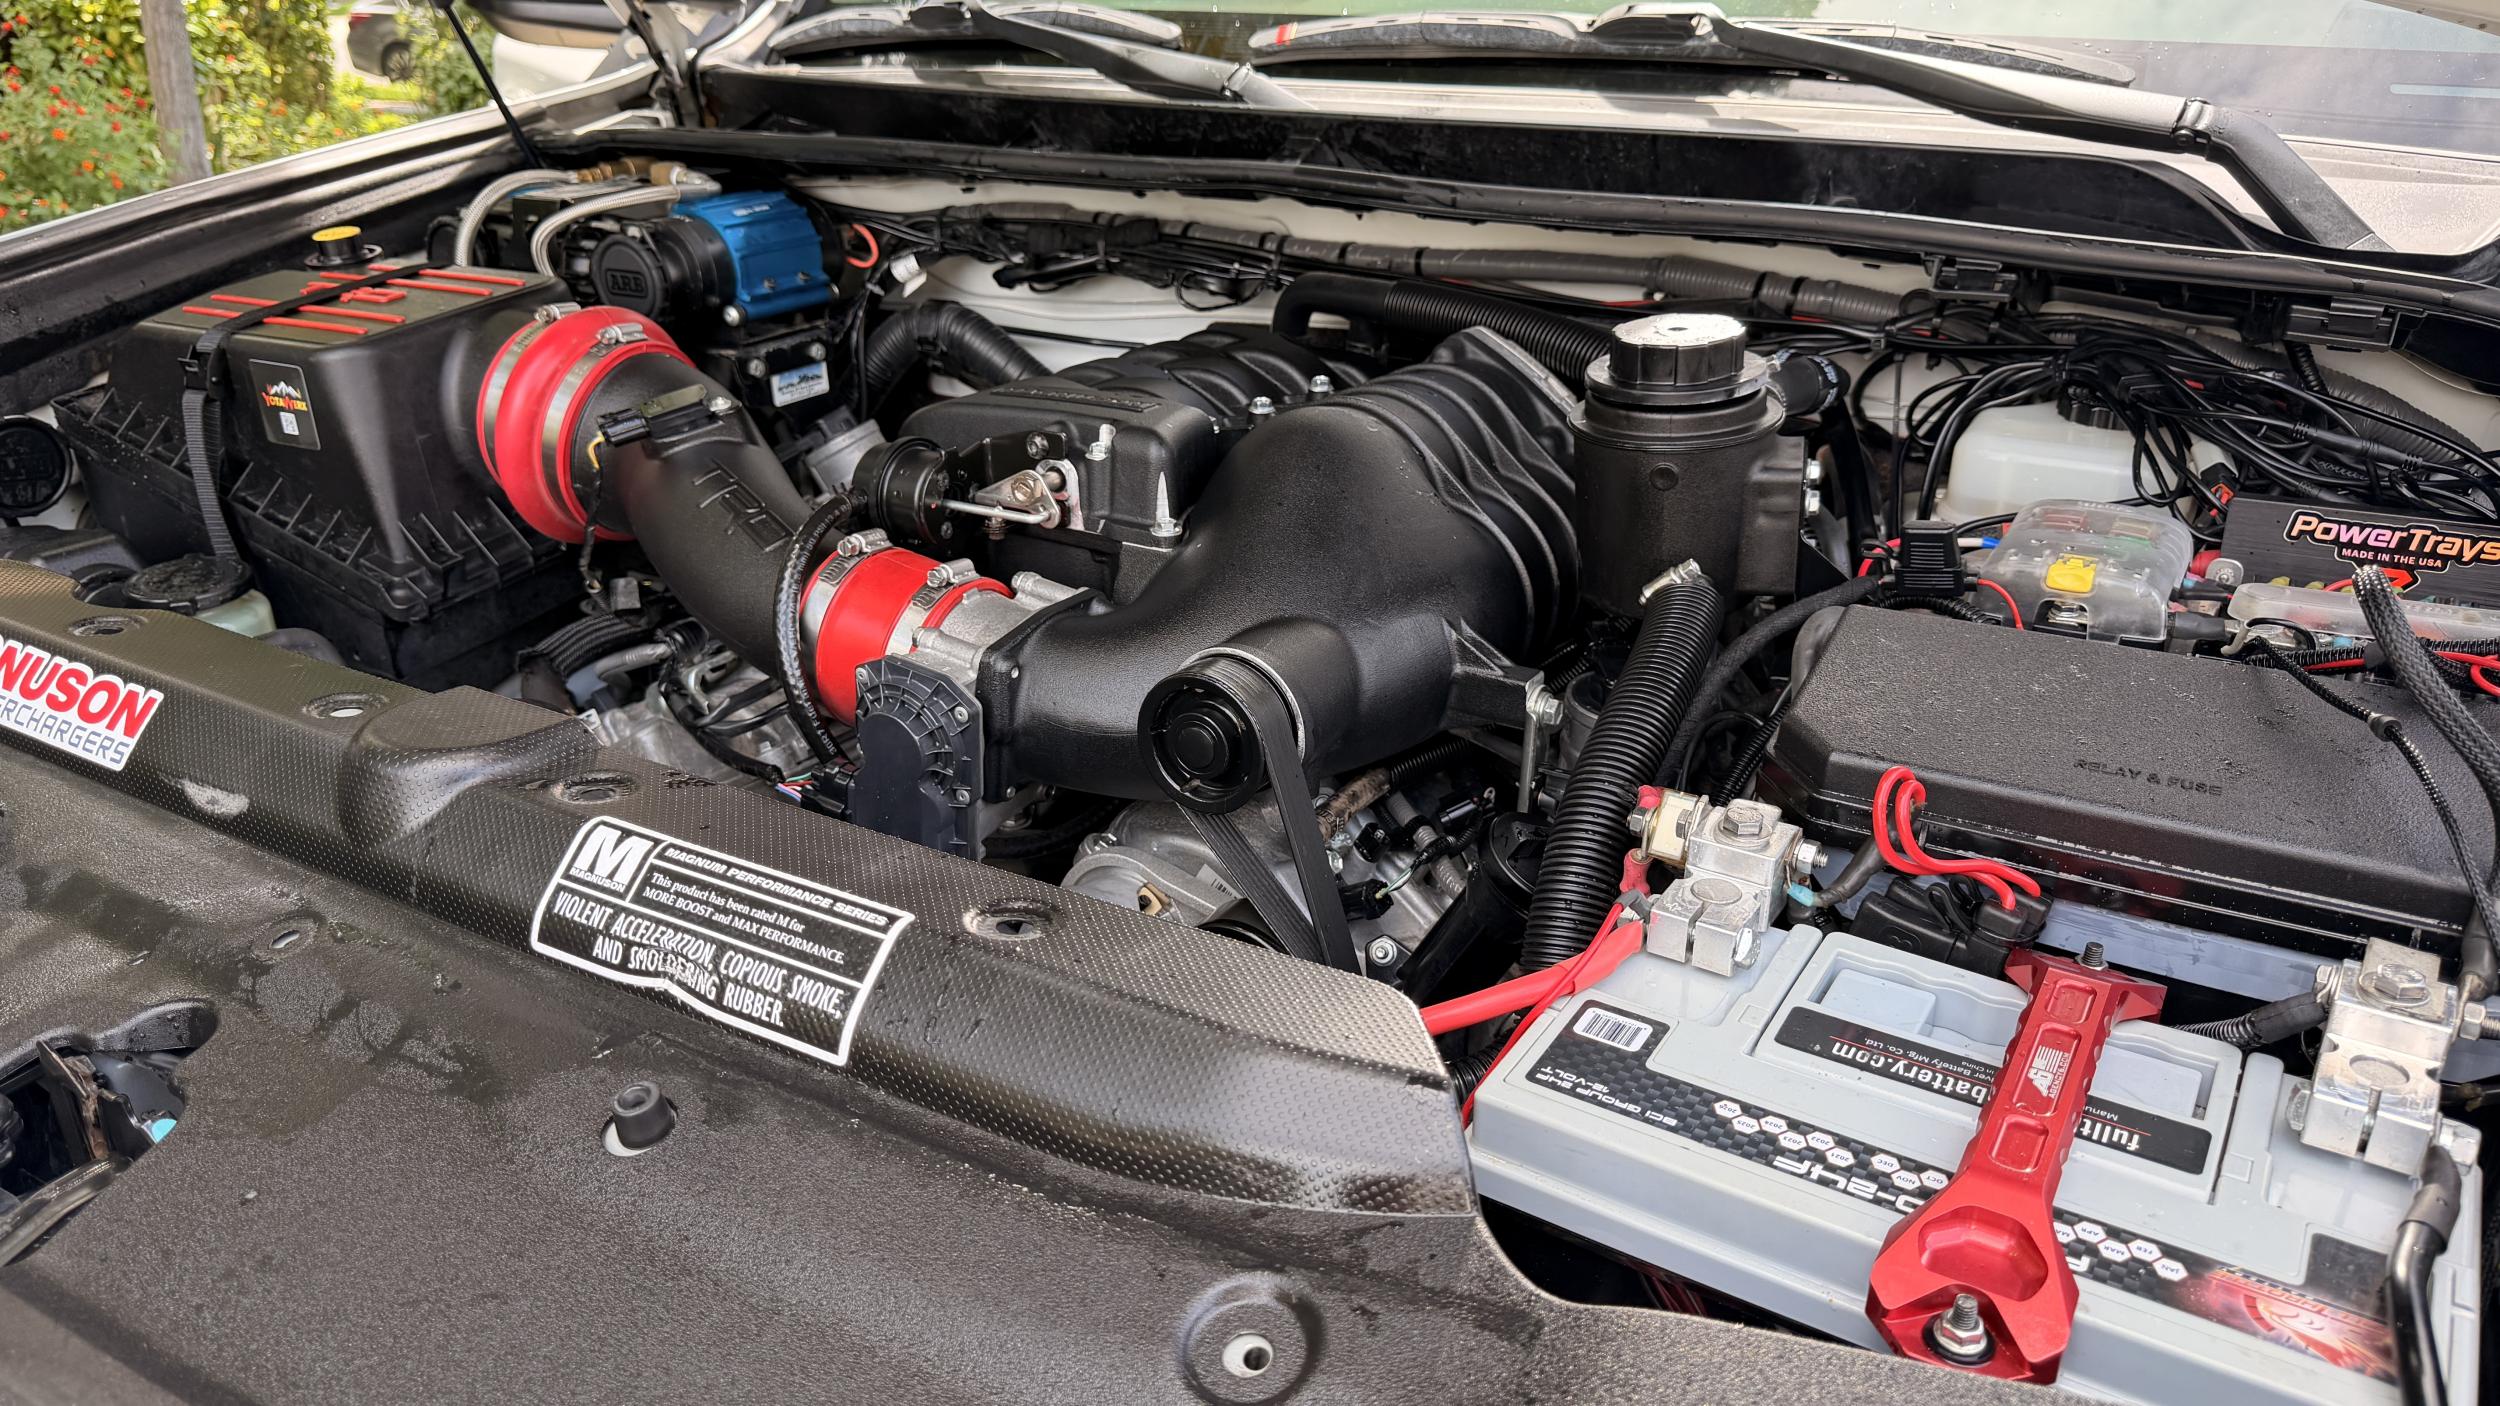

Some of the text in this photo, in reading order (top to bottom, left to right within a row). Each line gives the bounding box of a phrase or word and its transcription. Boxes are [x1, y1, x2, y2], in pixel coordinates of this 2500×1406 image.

[610, 275, 645, 293] ARB
[693, 458, 796, 552] TRD
[2290, 514, 2500, 562] PowerTrays
[2341, 548, 2442, 568] MADE IN THE USA
[2073, 759, 2223, 796] RELAY & FUSE
[574, 825, 654, 886] M
[569, 867, 627, 892] MAGNUSON
[664, 847, 889, 927] MAGNUM PERFORMANCE SERIES
[650, 872, 805, 932] This product has been rated M for
[642, 886, 844, 965] MORE BOOST and MAX PERFORMANCE.
[552, 891, 844, 1019] VIOLENT ACCELERATION, COPIOUS SMOKE,
[592, 935, 784, 1027] AND SMOLDERING RUBBER.
[1864, 1036, 1884, 1050] Ltd.
[1886, 1044, 1904, 1055] Co.
[1906, 1050, 1930, 1064] Mfg.
[1540, 1065, 1610, 1093] 12-VOLT
[1831, 1041, 1988, 1104] battery.com
[1575, 1086, 1643, 1114] GROUP
[1645, 1110, 1678, 1127] BCI
[1737, 1120, 1756, 1130] 2025
[1782, 1136, 1802, 1146] 2023
[1811, 1136, 1830, 1146] 2022
[1831, 1152, 1851, 1162] 2021
[1876, 1158, 1895, 1169] DEC
[1895, 1175, 1916, 1185] NOV
[1926, 1174, 1944, 1185] OCT
[2103, 1246, 2125, 1256] MAR
[2161, 1264, 2180, 1274] JAN
